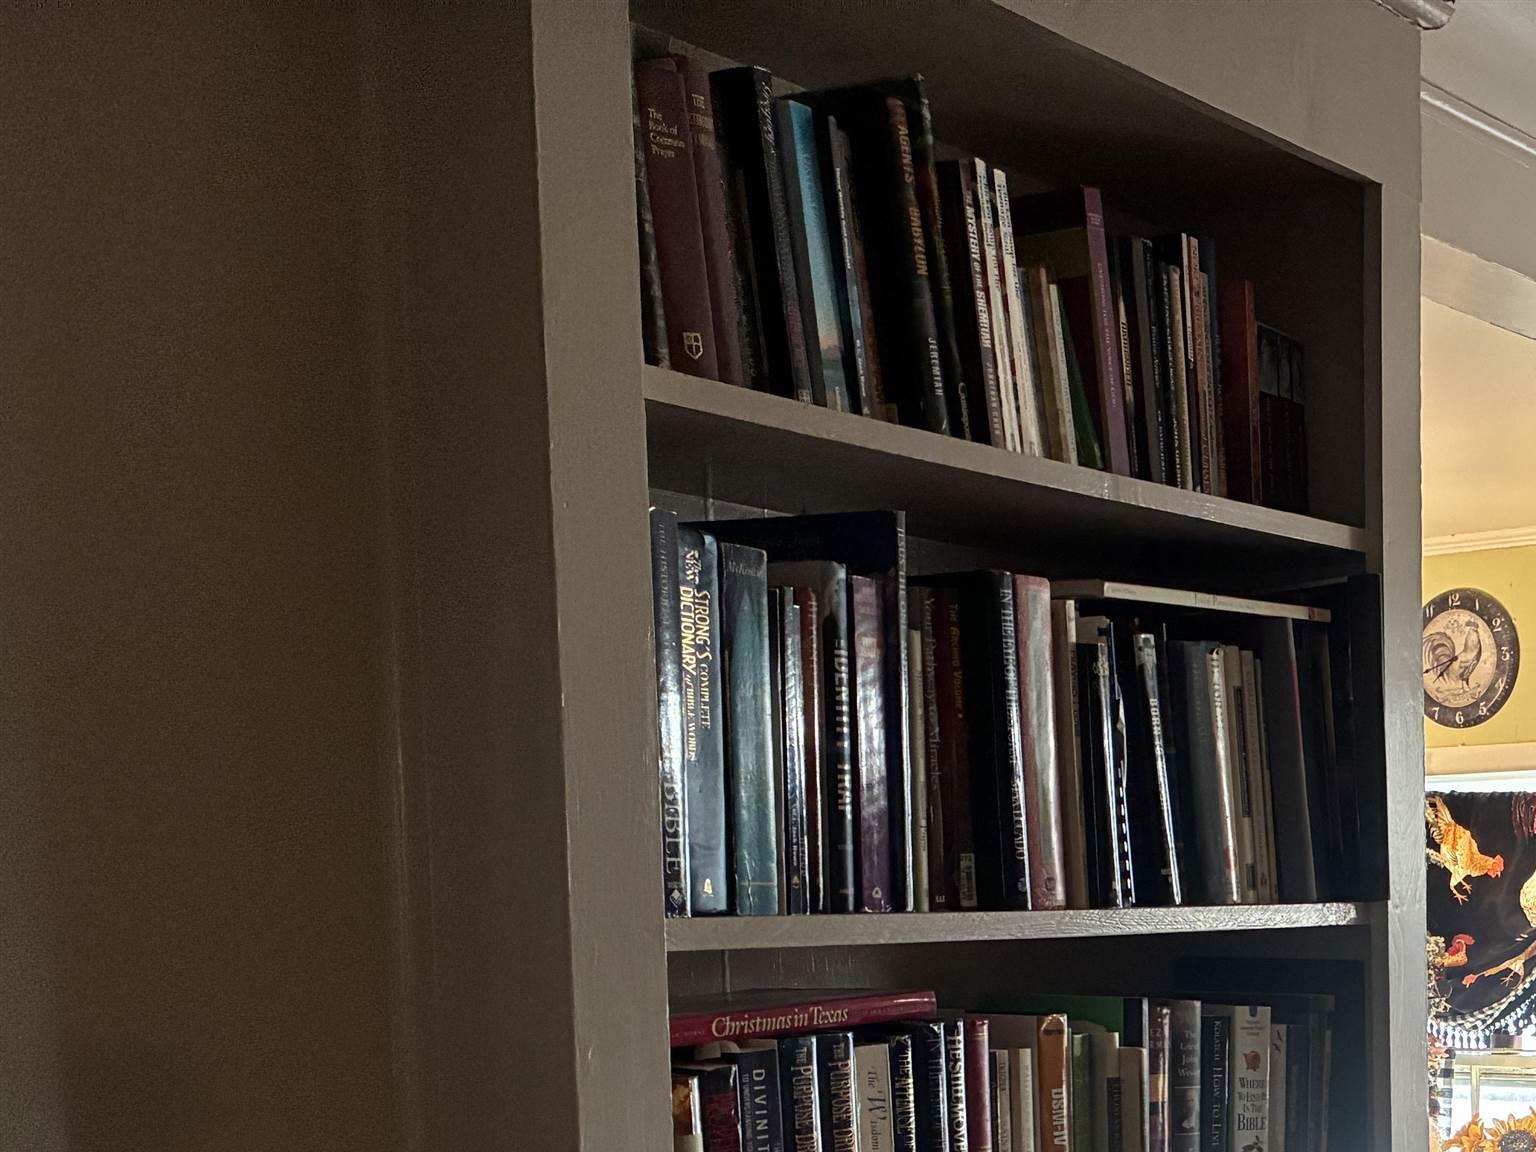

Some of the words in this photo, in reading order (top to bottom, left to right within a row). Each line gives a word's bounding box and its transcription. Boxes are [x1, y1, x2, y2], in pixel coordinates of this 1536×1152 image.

[895, 123, 914, 184] AGENTS
[966, 205, 979, 262] MYSTERY
[926, 335, 945, 396] JEREMIAH
[1449, 593, 1461, 606] 12
[678, 585, 696, 676] DICTIONARY
[1492, 617, 1502, 632] 2
[1501, 646, 1510, 661] 3
[697, 663, 711, 729] COMPLETE
[1432, 707, 1440, 721] 7
[1455, 711, 1464, 725] 6
[1479, 702, 1487, 716] 5
[660, 781, 683, 874] BIBLE
[711, 1012, 792, 1038] Christmas
[794, 1008, 809, 1028] in
[810, 1005, 849, 1026] Texas
[790, 1064, 815, 1129] PURPOSE
[827, 1060, 853, 1122] PURPOSE
[1212, 1066, 1223, 1097] HOW
[1050, 1088, 1067, 1144] DSM-IV
[1238, 1114, 1266, 1131] BIBLE
